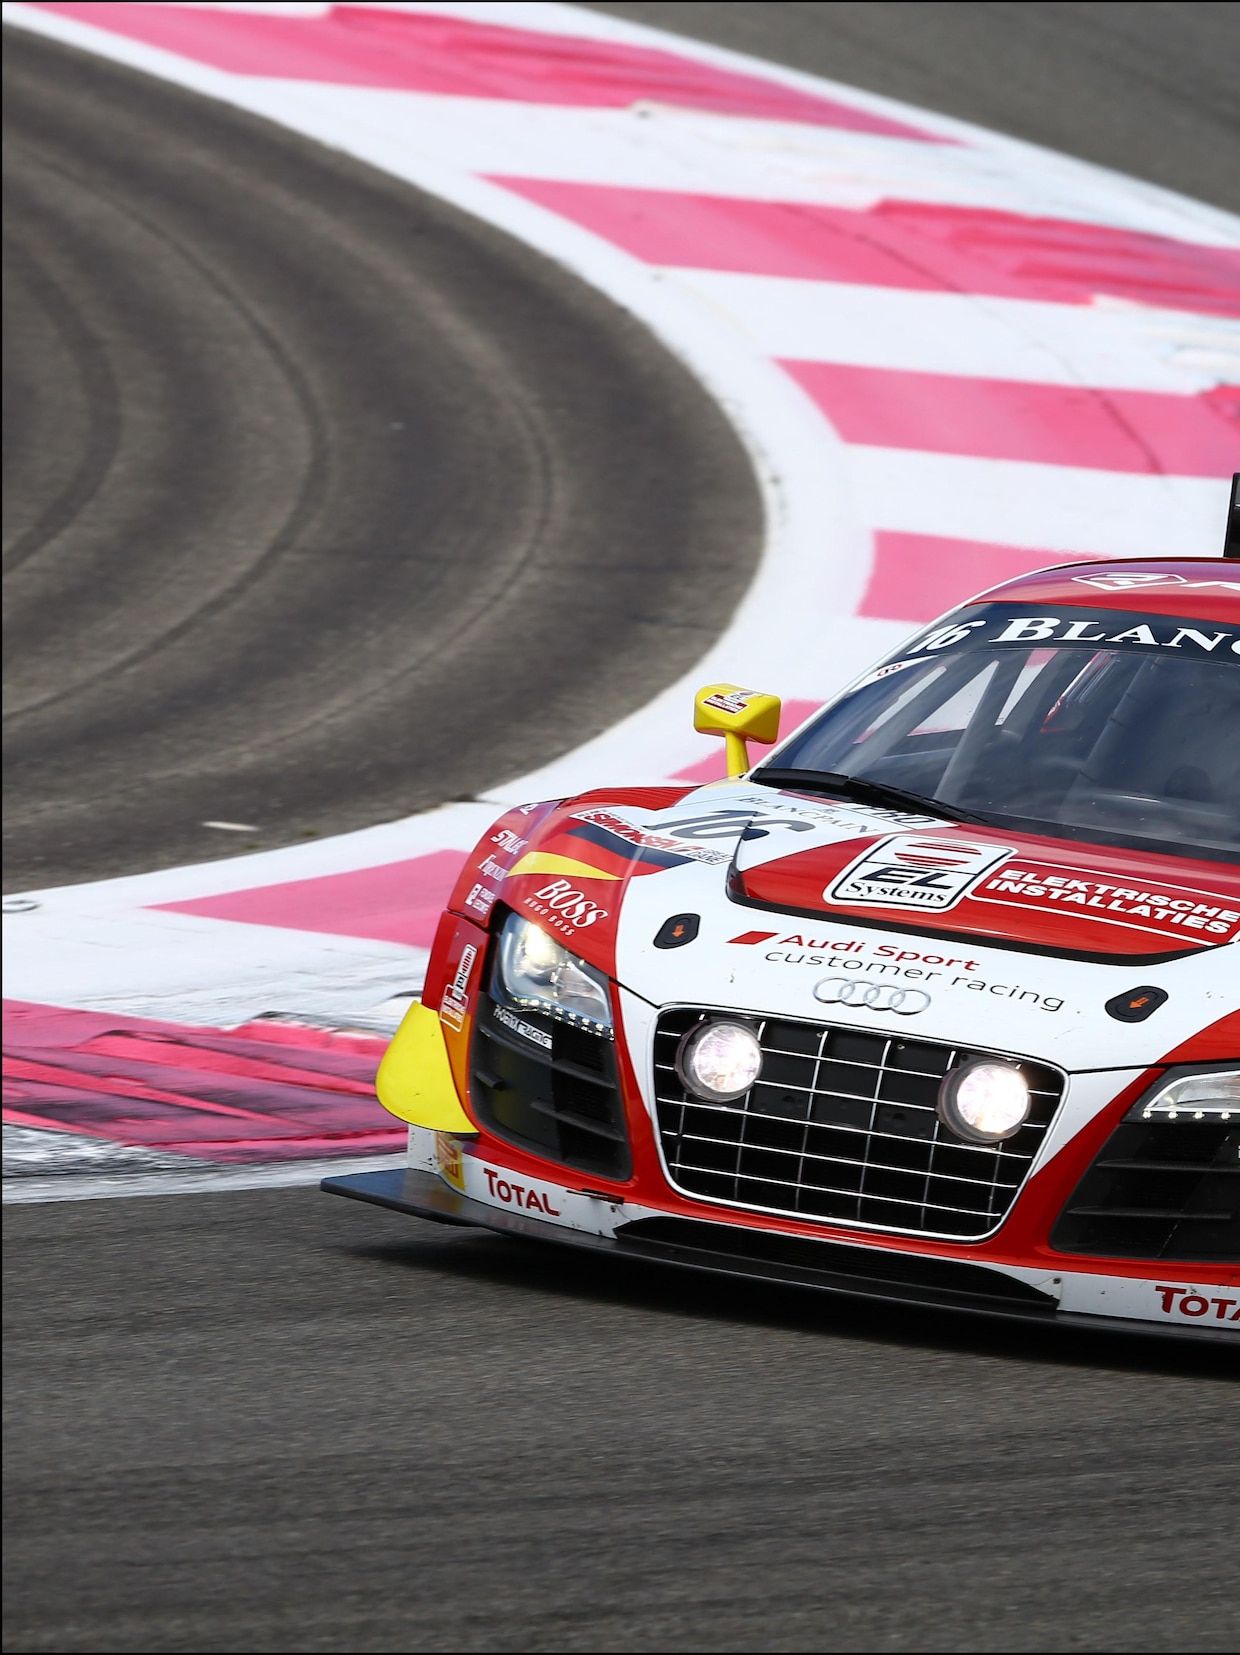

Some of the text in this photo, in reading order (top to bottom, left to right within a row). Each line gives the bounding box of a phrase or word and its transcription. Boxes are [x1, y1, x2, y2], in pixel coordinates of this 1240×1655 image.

[906, 619, 986, 655] 16
[642, 809, 816, 841] 16
[737, 797, 880, 833] BLANCPAIN
[846, 881, 948, 904] Systems
[857, 867, 958, 890] EL
[523, 897, 575, 936] HUGO BOSS
[534, 879, 609, 928] BOSS
[984, 879, 1231, 935] INSTALLATIES
[777, 934, 981, 971] Audi Sport
[764, 950, 1066, 1012] customer racing
[483, 1167, 560, 1217] TOTAL
